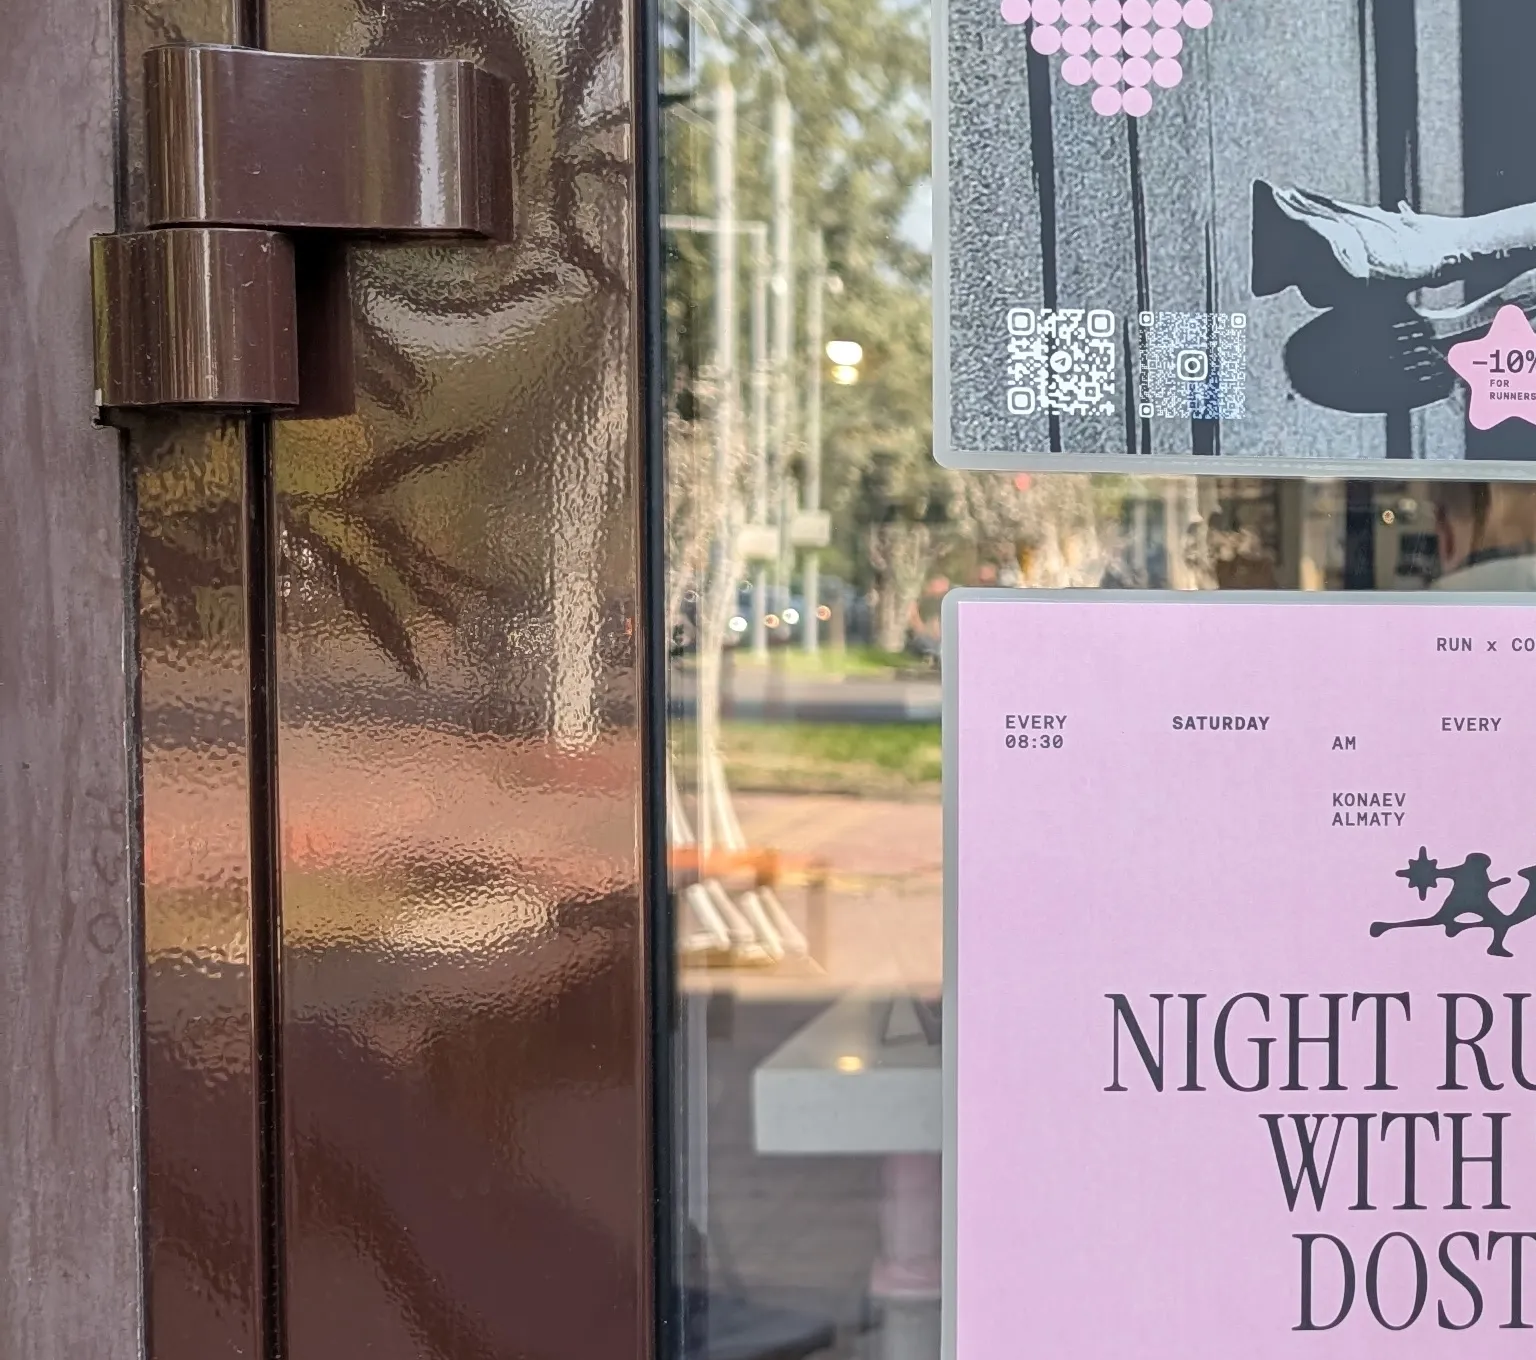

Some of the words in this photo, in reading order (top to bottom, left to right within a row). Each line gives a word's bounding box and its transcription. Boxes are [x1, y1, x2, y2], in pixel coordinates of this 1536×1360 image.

[1489, 379, 1510, 388] FOR
[1489, 392, 1536, 400] RUNNERS
[1436, 637, 1473, 652] RUN
[1487, 640, 1498, 652] x
[1005, 715, 1067, 730] EVERY
[1172, 716, 1270, 731] SATURDAY
[1441, 717, 1502, 732] EVERY
[1005, 734, 1064, 749] 08:30
[1331, 736, 1356, 750] AM
[1332, 793, 1406, 807] KONAEV
[1331, 812, 1405, 827] ALMATY
[1104, 991, 1412, 1093] NIGHT
[1259, 1111, 1512, 1212] WITH
